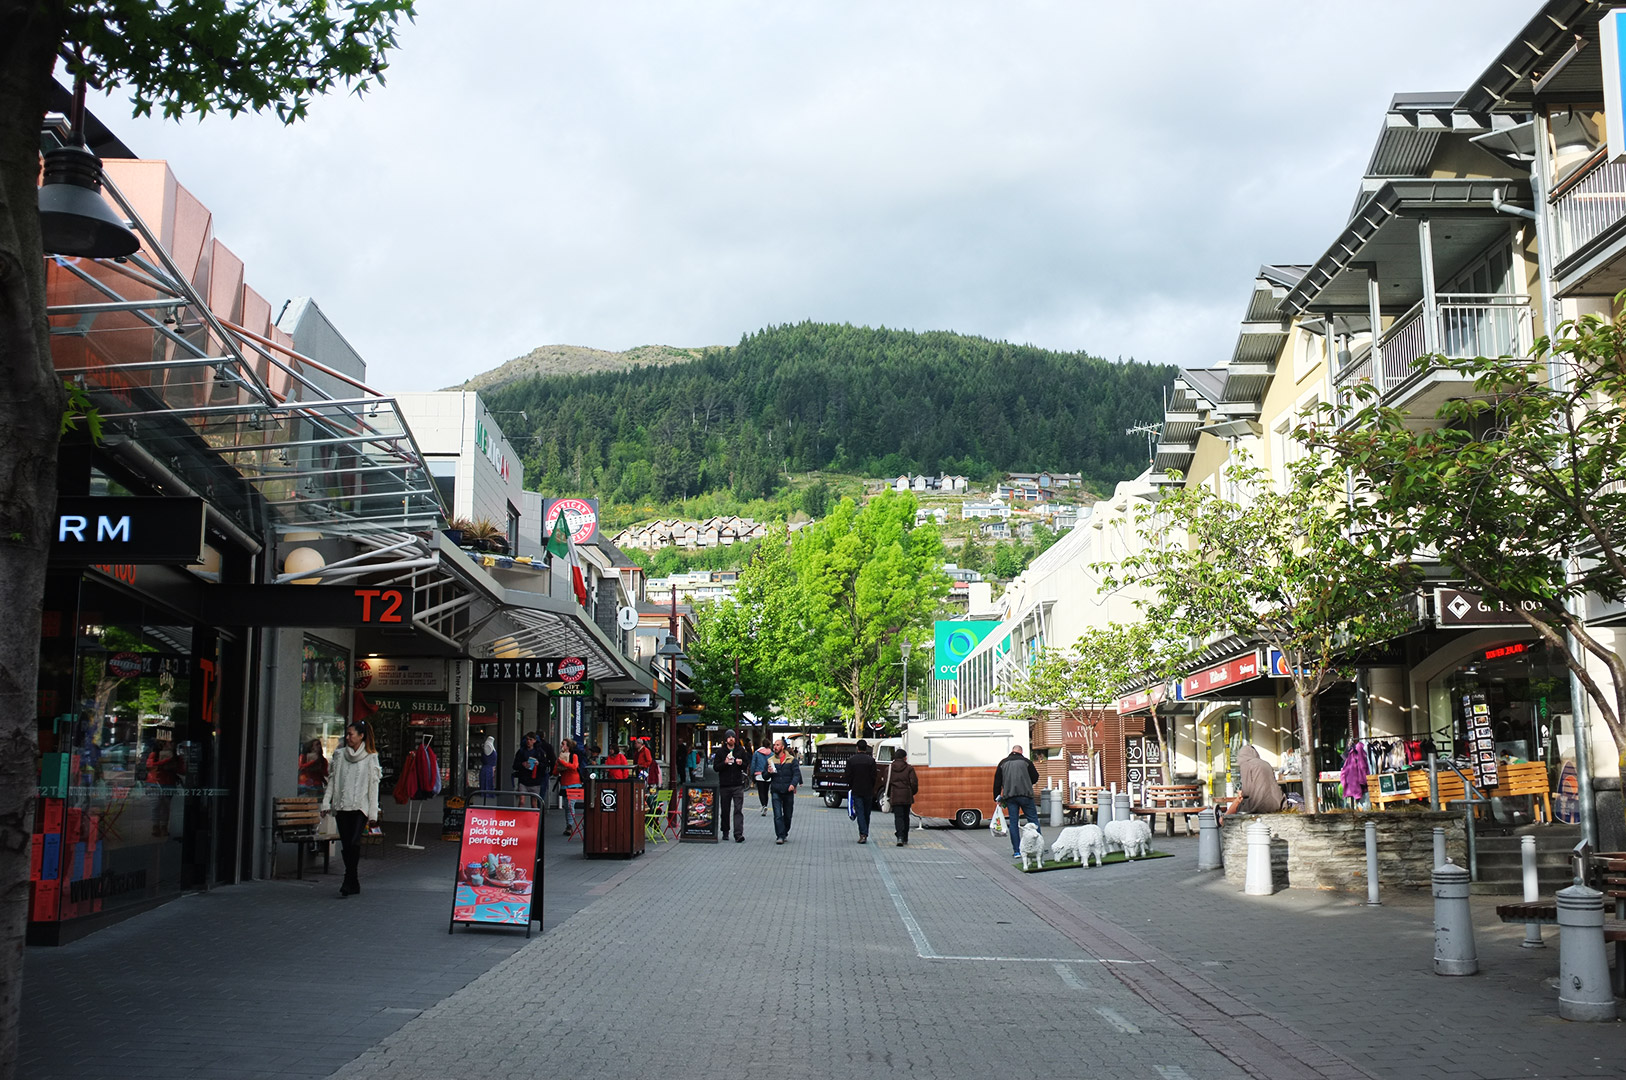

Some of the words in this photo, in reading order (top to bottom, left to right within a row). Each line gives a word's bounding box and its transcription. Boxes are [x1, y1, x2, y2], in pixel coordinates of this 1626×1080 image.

[354, 589, 403, 623] T2
[479, 662, 554, 679] MEXICAN
[412, 702, 447, 712] SHELL
[471, 817, 489, 827] Pop
[490, 817, 498, 825] in
[499, 819, 516, 827] and
[469, 828, 488, 836] pick
[489, 828, 503, 836] the
[469, 836, 500, 845] perfect
[501, 838, 519, 847] gift!
[513, 910, 524, 919] T2
